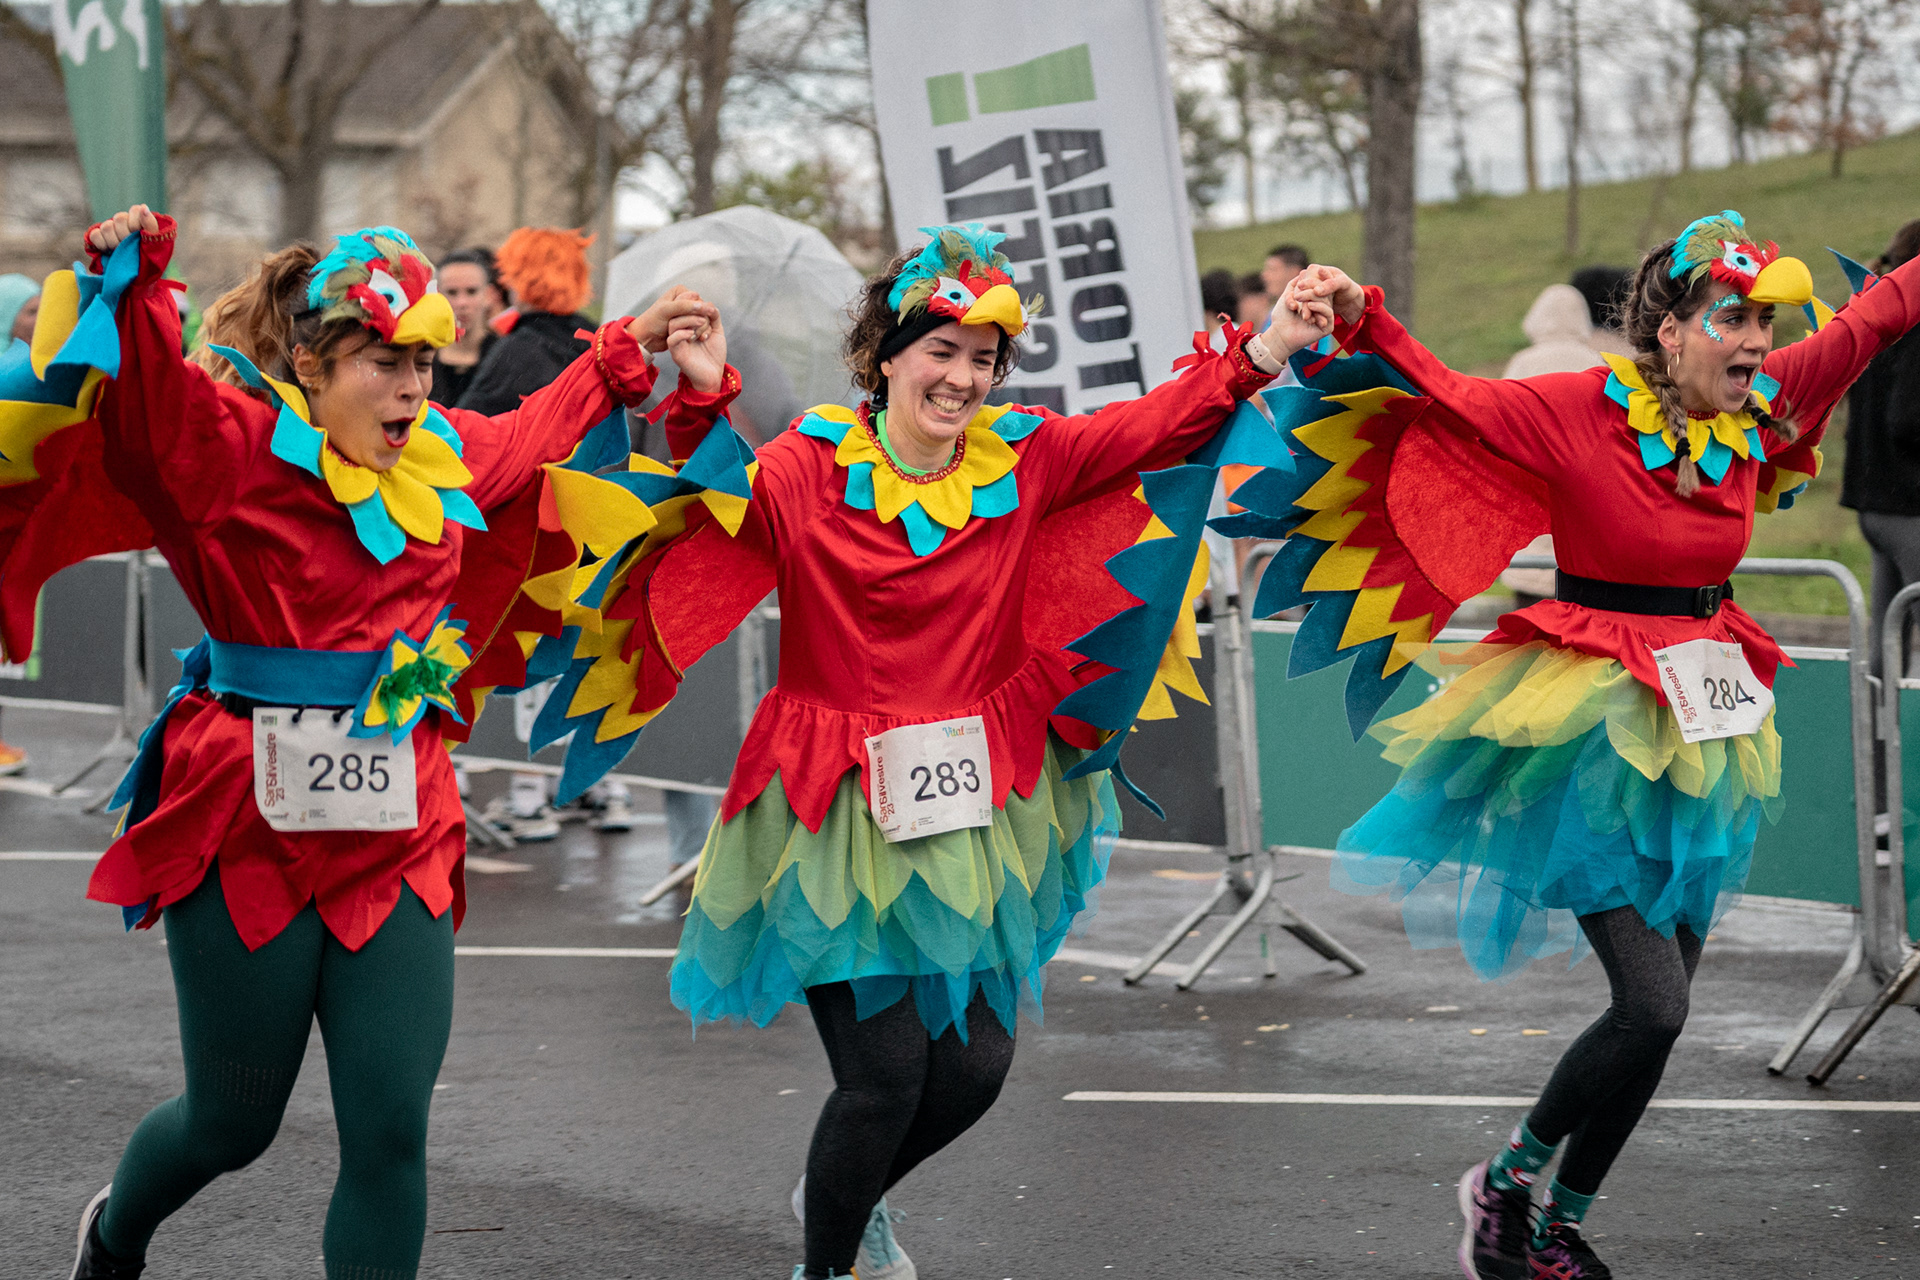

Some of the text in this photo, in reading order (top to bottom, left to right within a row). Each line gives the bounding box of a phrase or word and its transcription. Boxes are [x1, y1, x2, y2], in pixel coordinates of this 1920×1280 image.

[1704, 677, 1757, 711] 284
[1689, 706, 1698, 718] 23
[942, 725, 965, 738] Vital
[308, 753, 390, 792] 285
[910, 758, 981, 802] 283
[275, 787, 285, 801] 23
[887, 803, 896, 815] 23
